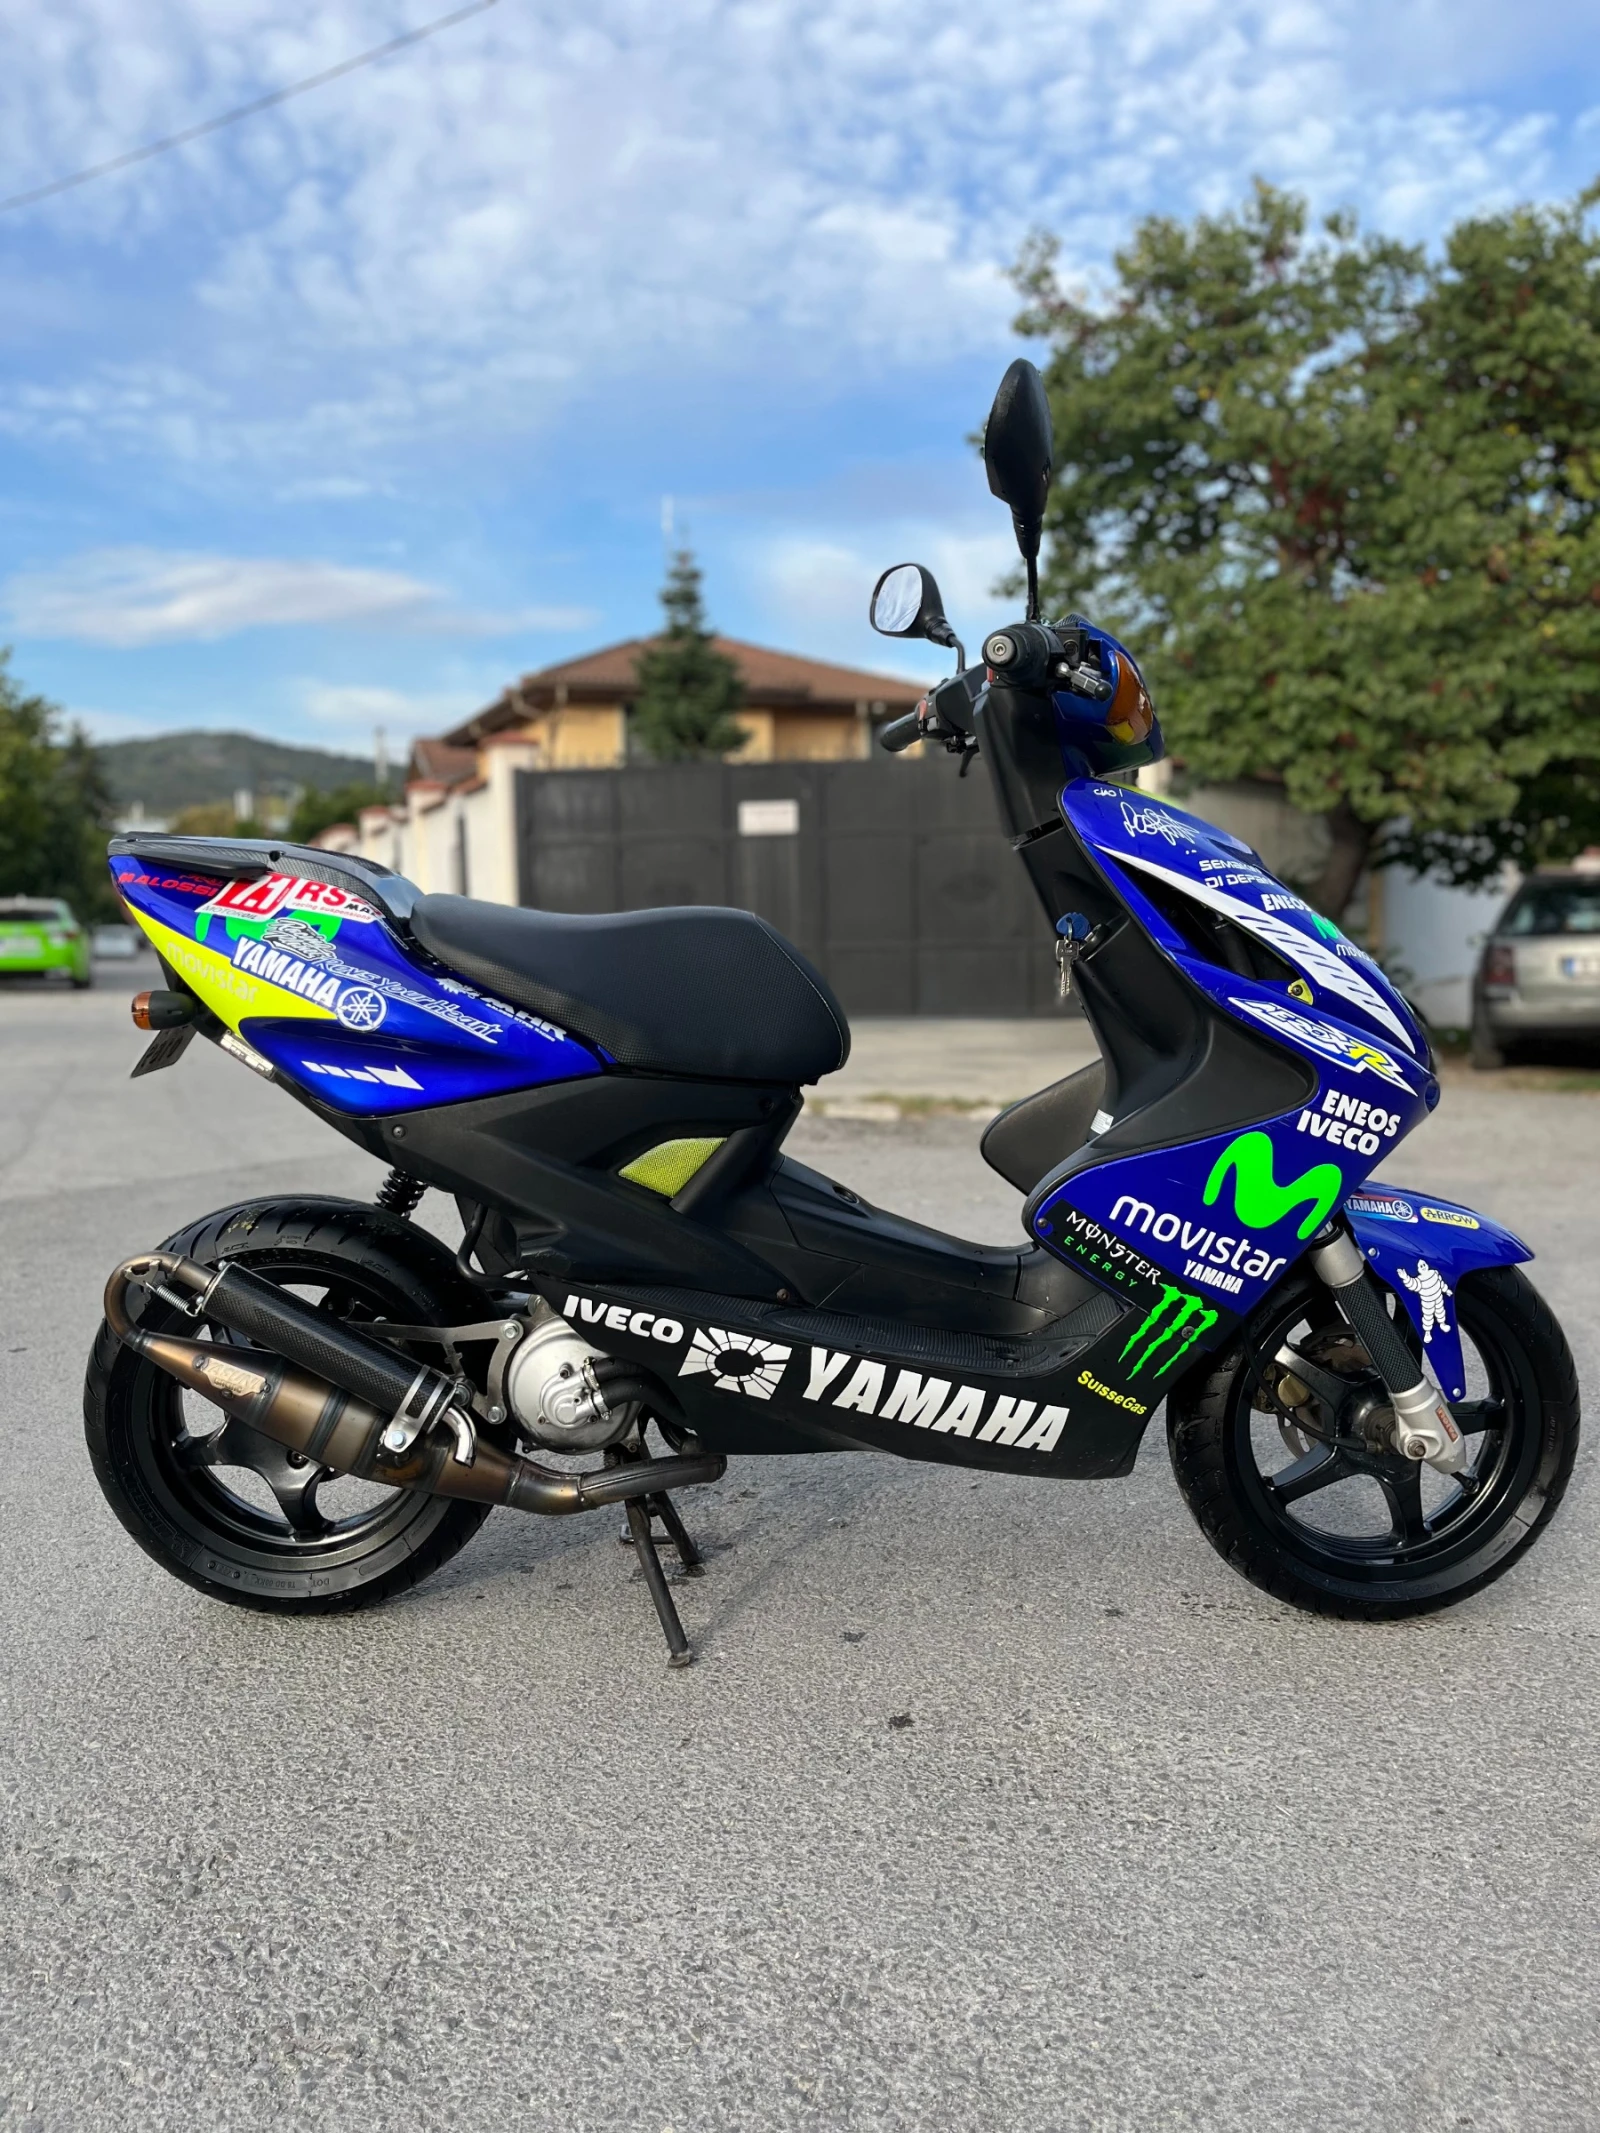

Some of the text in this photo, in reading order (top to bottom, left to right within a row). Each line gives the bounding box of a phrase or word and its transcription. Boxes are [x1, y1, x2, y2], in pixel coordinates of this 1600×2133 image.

[117, 872, 219, 897] MALOSSI
[1204, 875, 1224, 889] DI
[166, 942, 259, 1005] movistar
[232, 936, 342, 1008] YAMAHA
[1296, 1109, 1381, 1156] IVECO
[1321, 1088, 1401, 1137] ENEOS
[1346, 1198, 1394, 1214] YAMAHA
[1424, 1208, 1473, 1226] ARROW
[1063, 1235, 1138, 1288] ENERGY
[1108, 1195, 1288, 1282] movistar
[1182, 1258, 1245, 1295] YAMAHA
[562, 1294, 684, 1344] IVECO
[802, 1346, 1070, 1452] YAMAHA
[1077, 1369, 1148, 1415] SuisseGas
[311, 1577, 330, 1588] DOT
